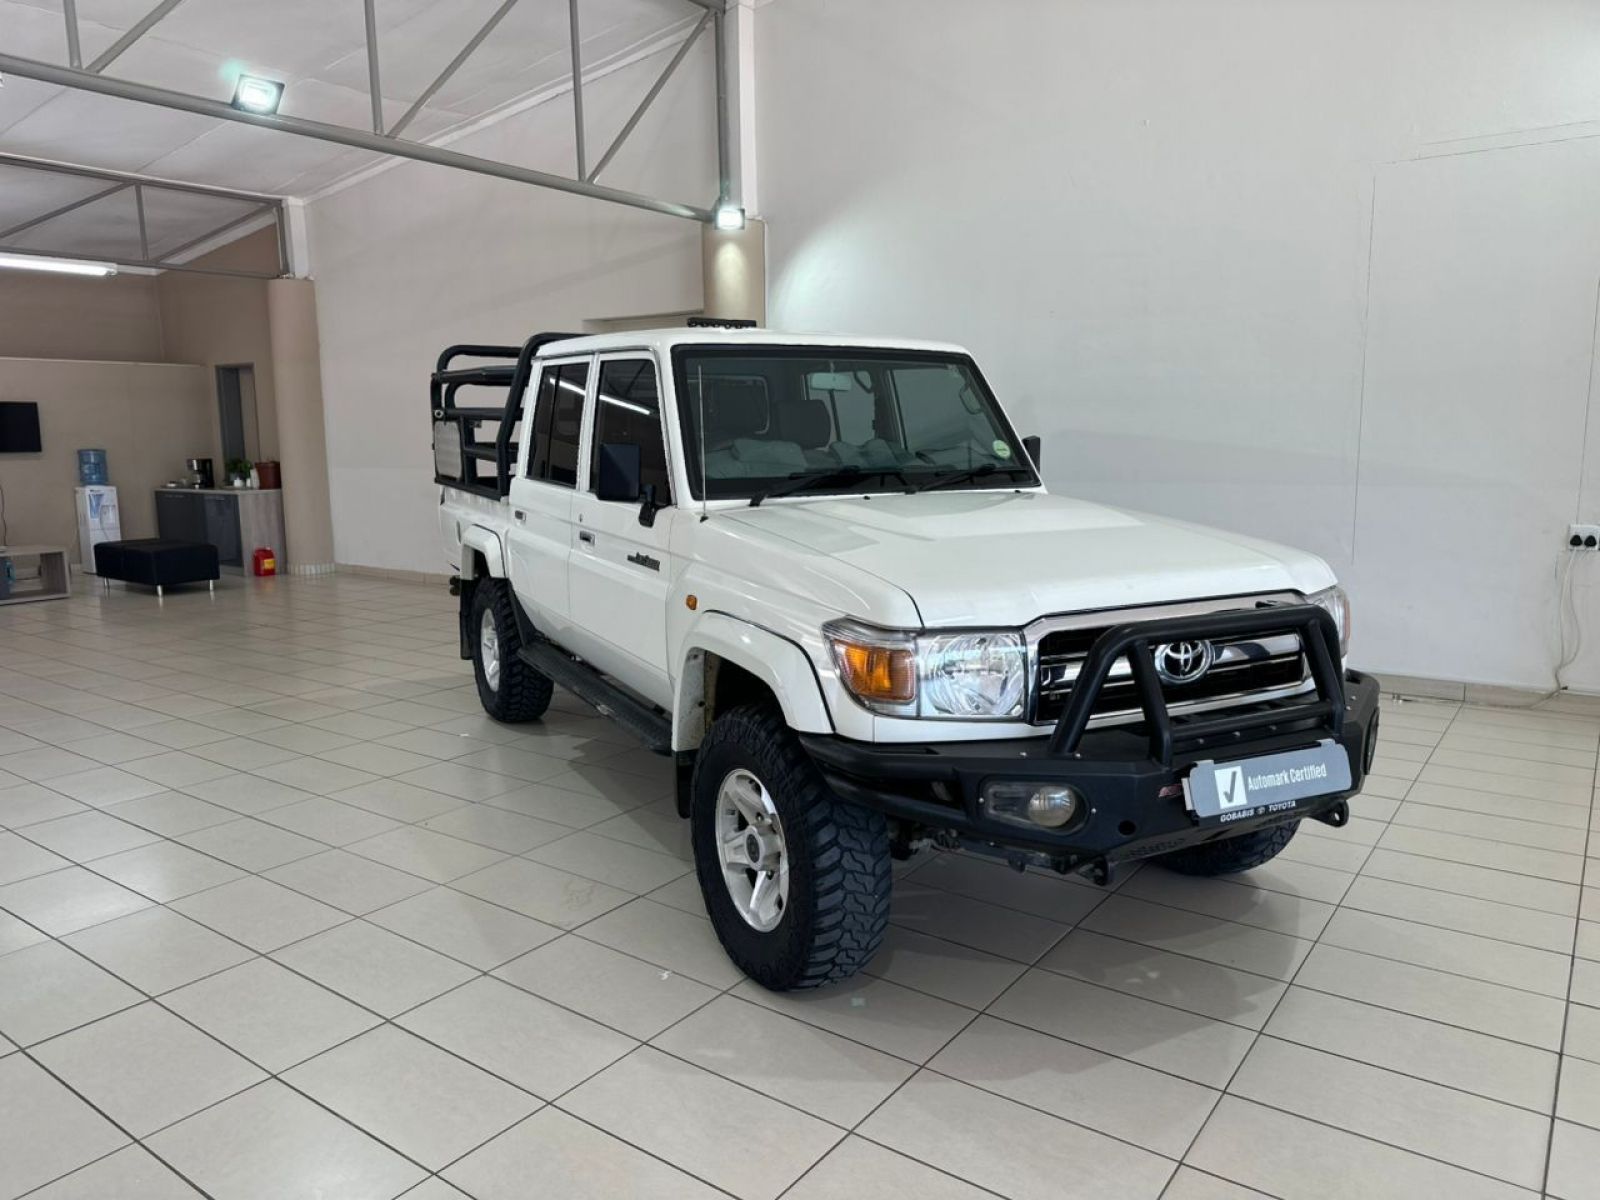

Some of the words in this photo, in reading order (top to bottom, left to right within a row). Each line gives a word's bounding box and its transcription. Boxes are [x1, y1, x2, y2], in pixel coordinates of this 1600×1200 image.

[1248, 770, 1290, 791] Automark
[1290, 763, 1327, 783] Certified
[1220, 808, 1254, 822] GOBABIS
[1268, 800, 1296, 812] TOYOTA
